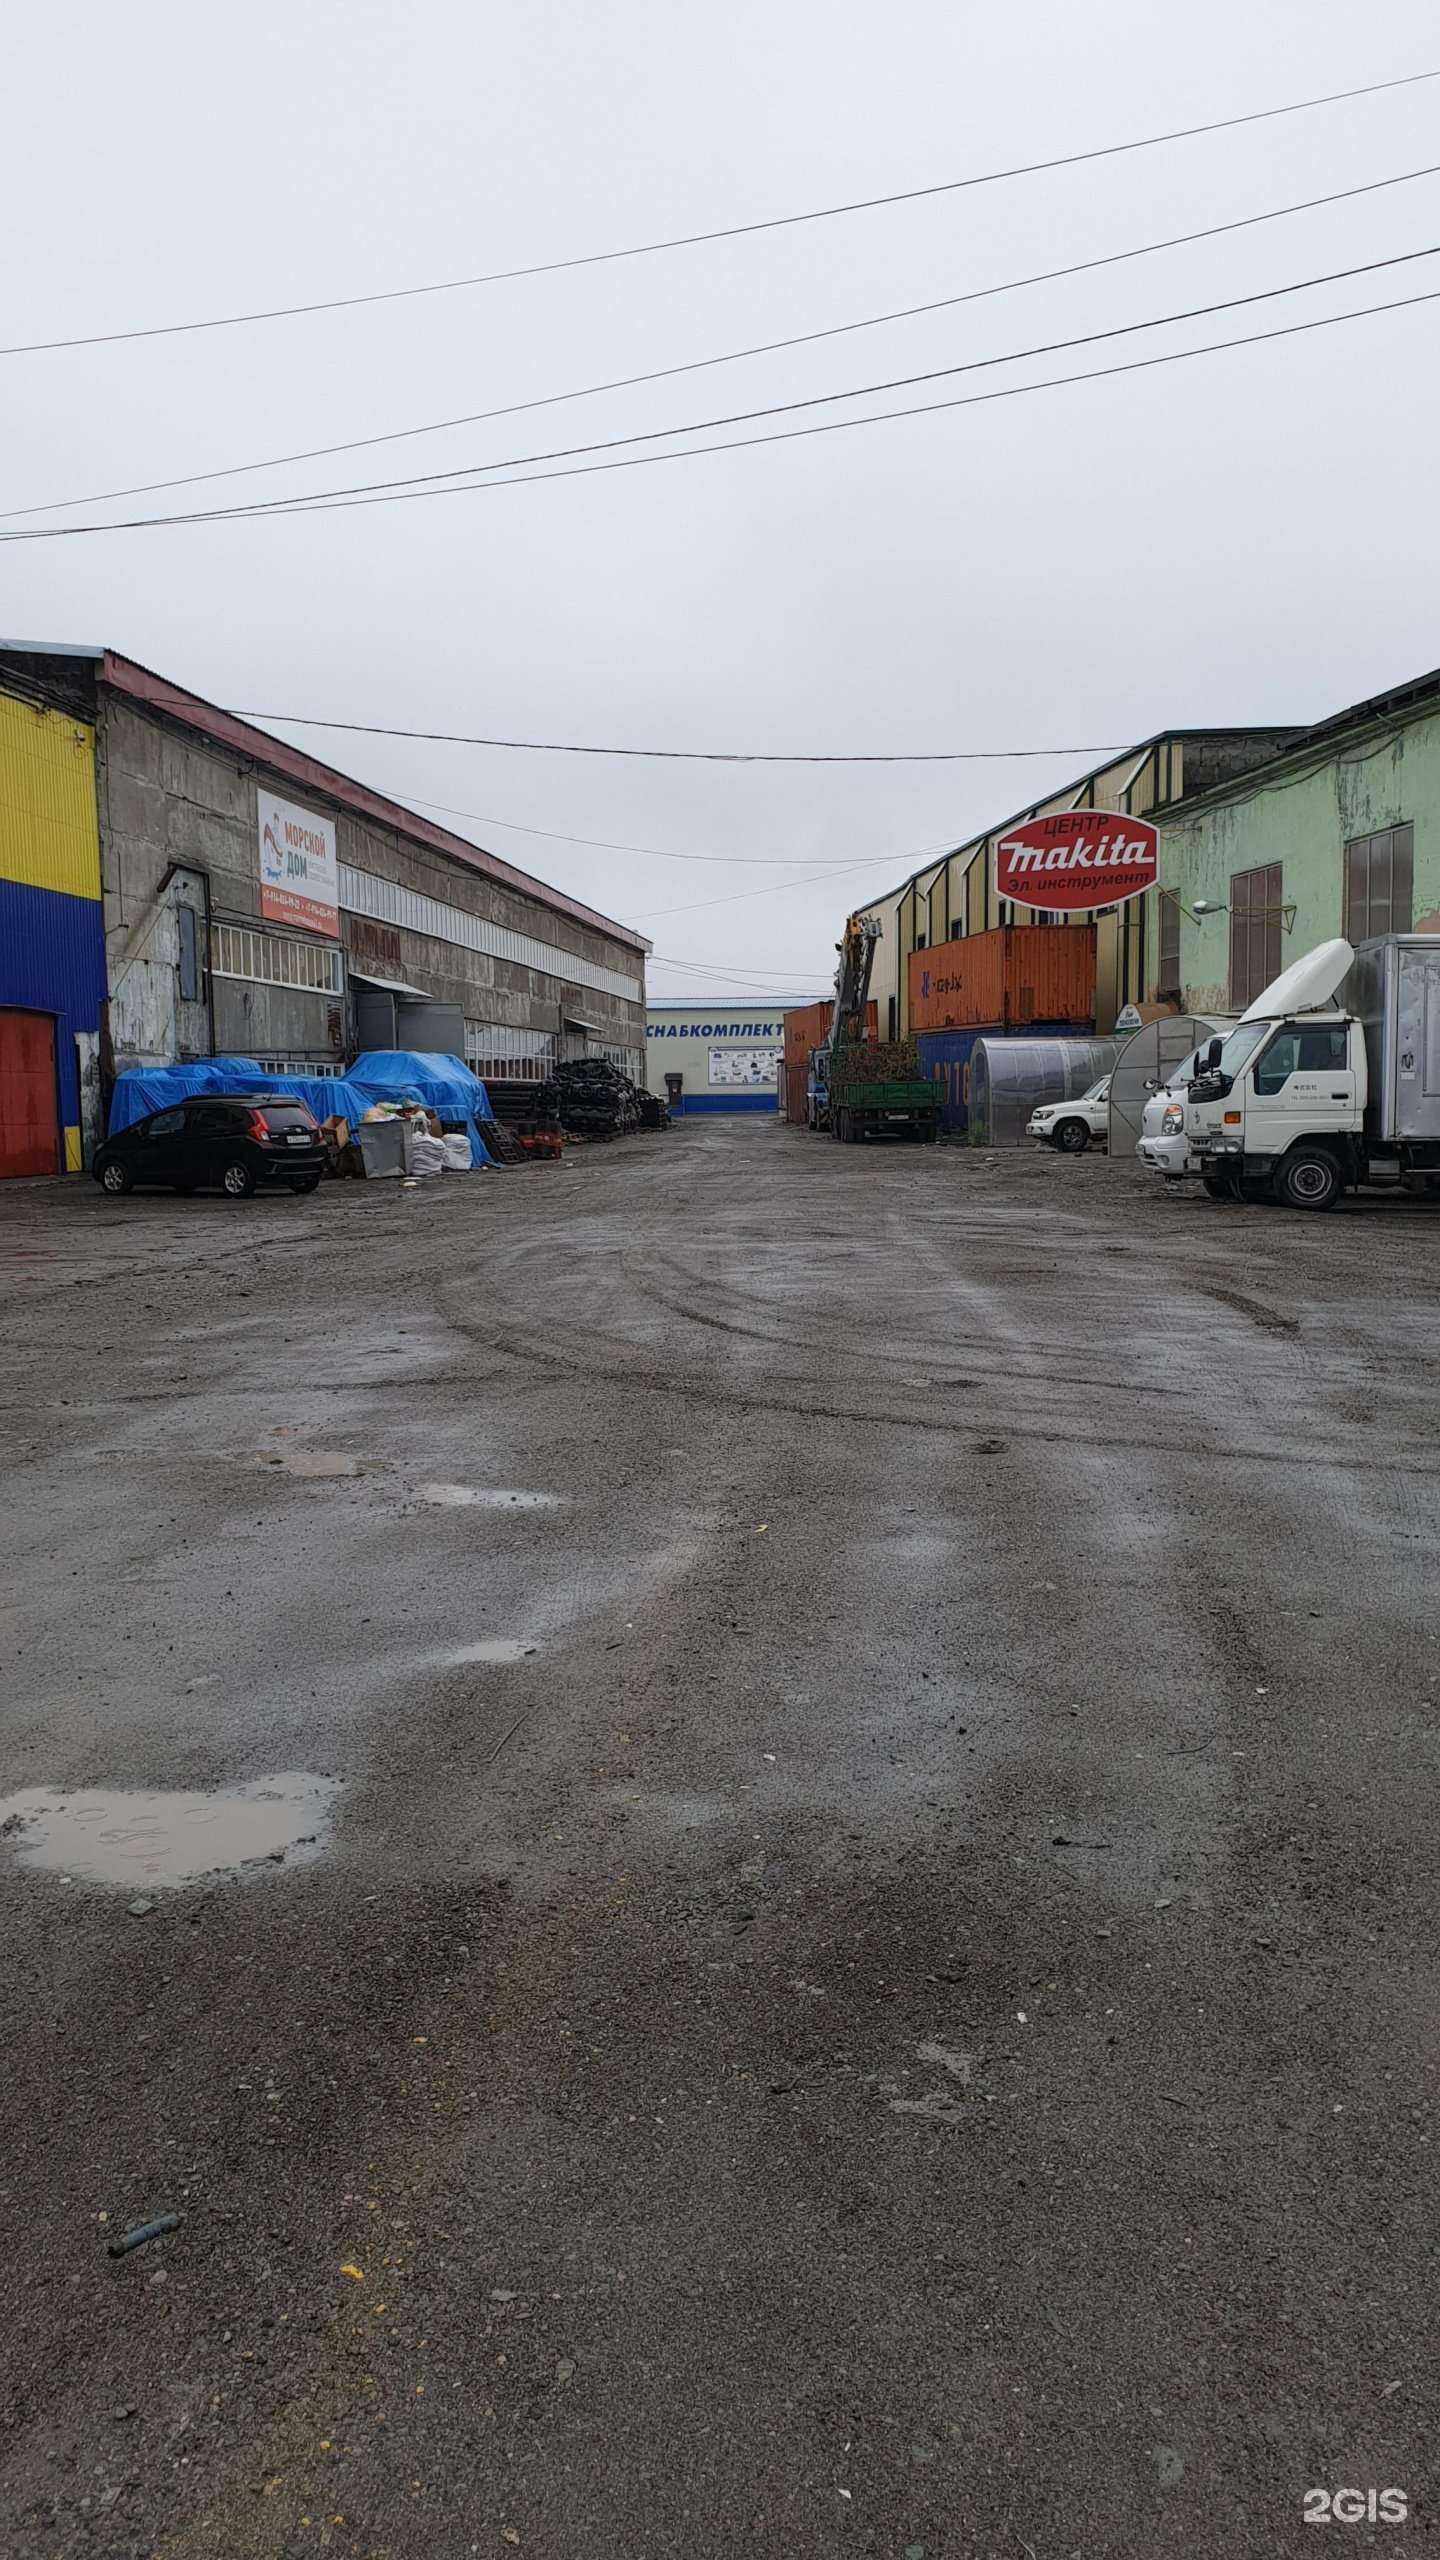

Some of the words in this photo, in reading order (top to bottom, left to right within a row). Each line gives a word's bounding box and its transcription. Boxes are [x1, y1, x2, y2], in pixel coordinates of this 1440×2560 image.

[1044, 816, 1109, 837] ЦЕНТР
[284, 821, 326, 858] МОРСКОЙ
[286, 850, 308, 880] ДОМ
[1008, 878, 1033, 892] Эл.
[1037, 872, 1150, 891] инструмент
[646, 1023, 784, 1038] СНАБКОМПЛЕКТ
